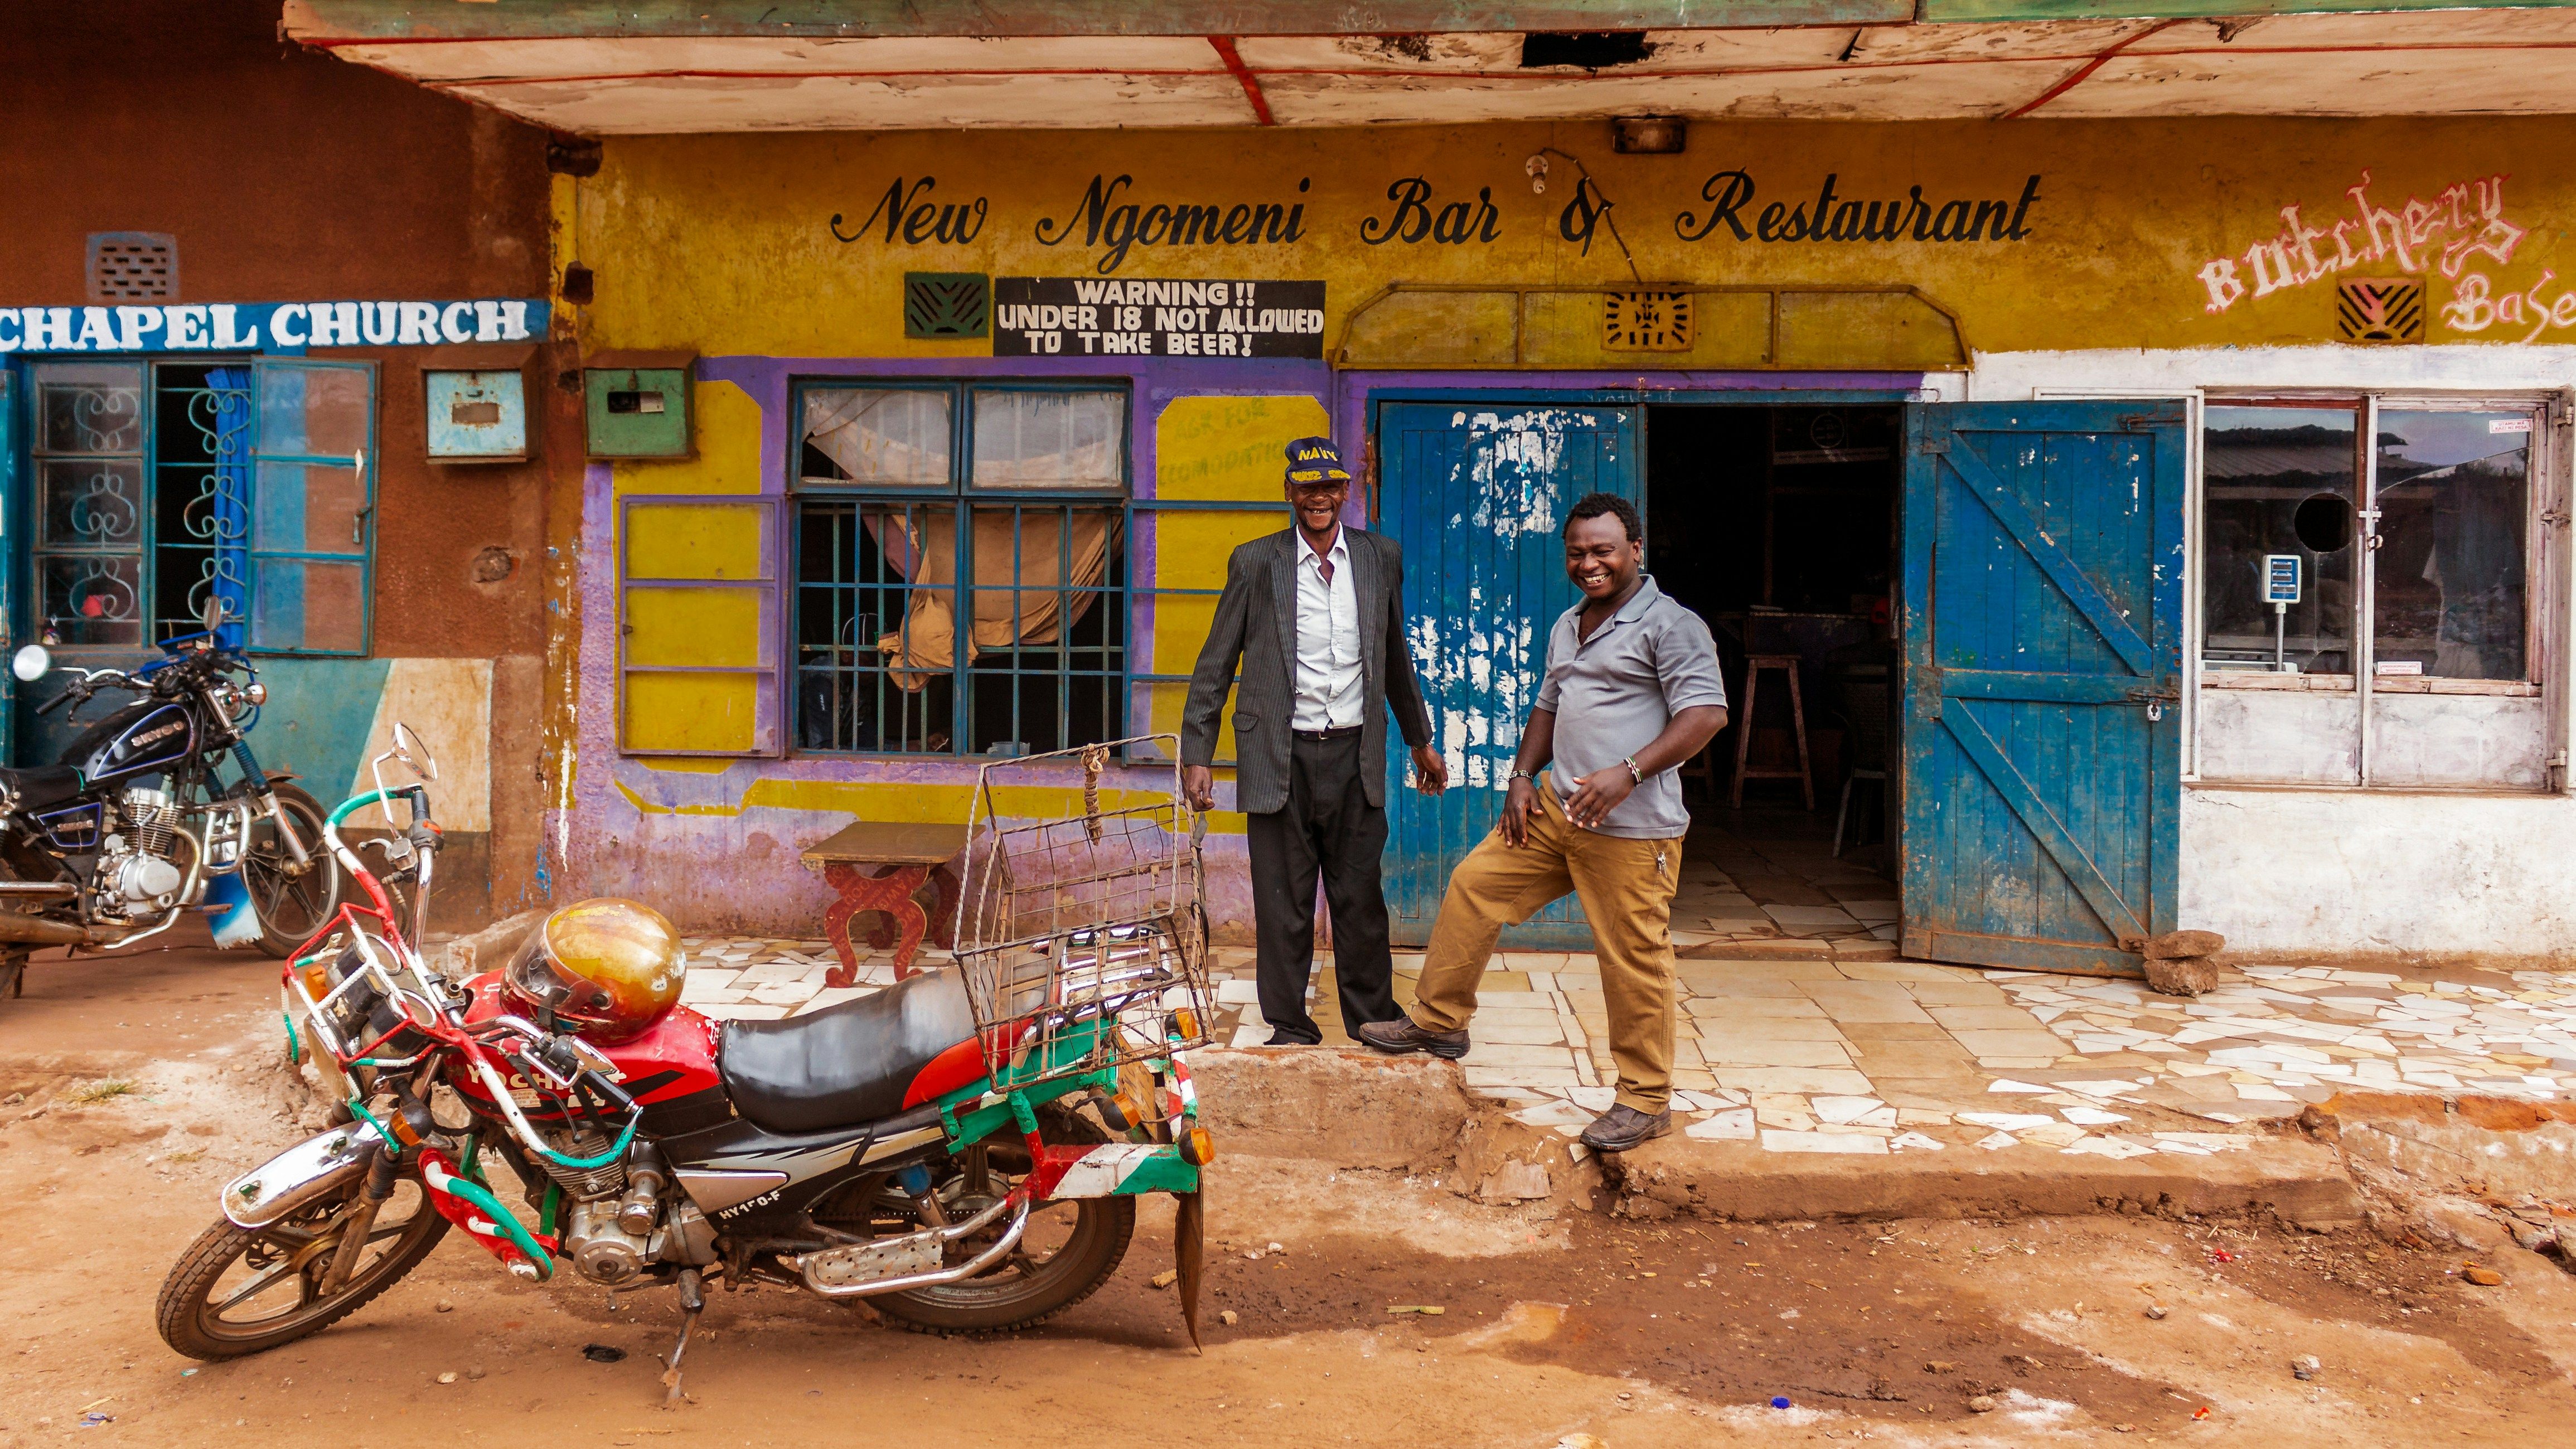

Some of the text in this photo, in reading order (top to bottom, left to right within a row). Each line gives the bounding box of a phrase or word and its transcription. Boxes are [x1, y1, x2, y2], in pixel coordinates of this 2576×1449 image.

[830, 167, 2041, 275] New Ngomeni Bar & Restaurant
[2197, 168, 2527, 313] Butchery
[0, 301, 530, 352] CHAPEL CHURCH
[998, 304, 1324, 333] UNDER 18 NOT ALLOWED
[1025, 331, 1252, 357] TO TAKE BEER!
[1298, 447, 1338, 462] NAVY
